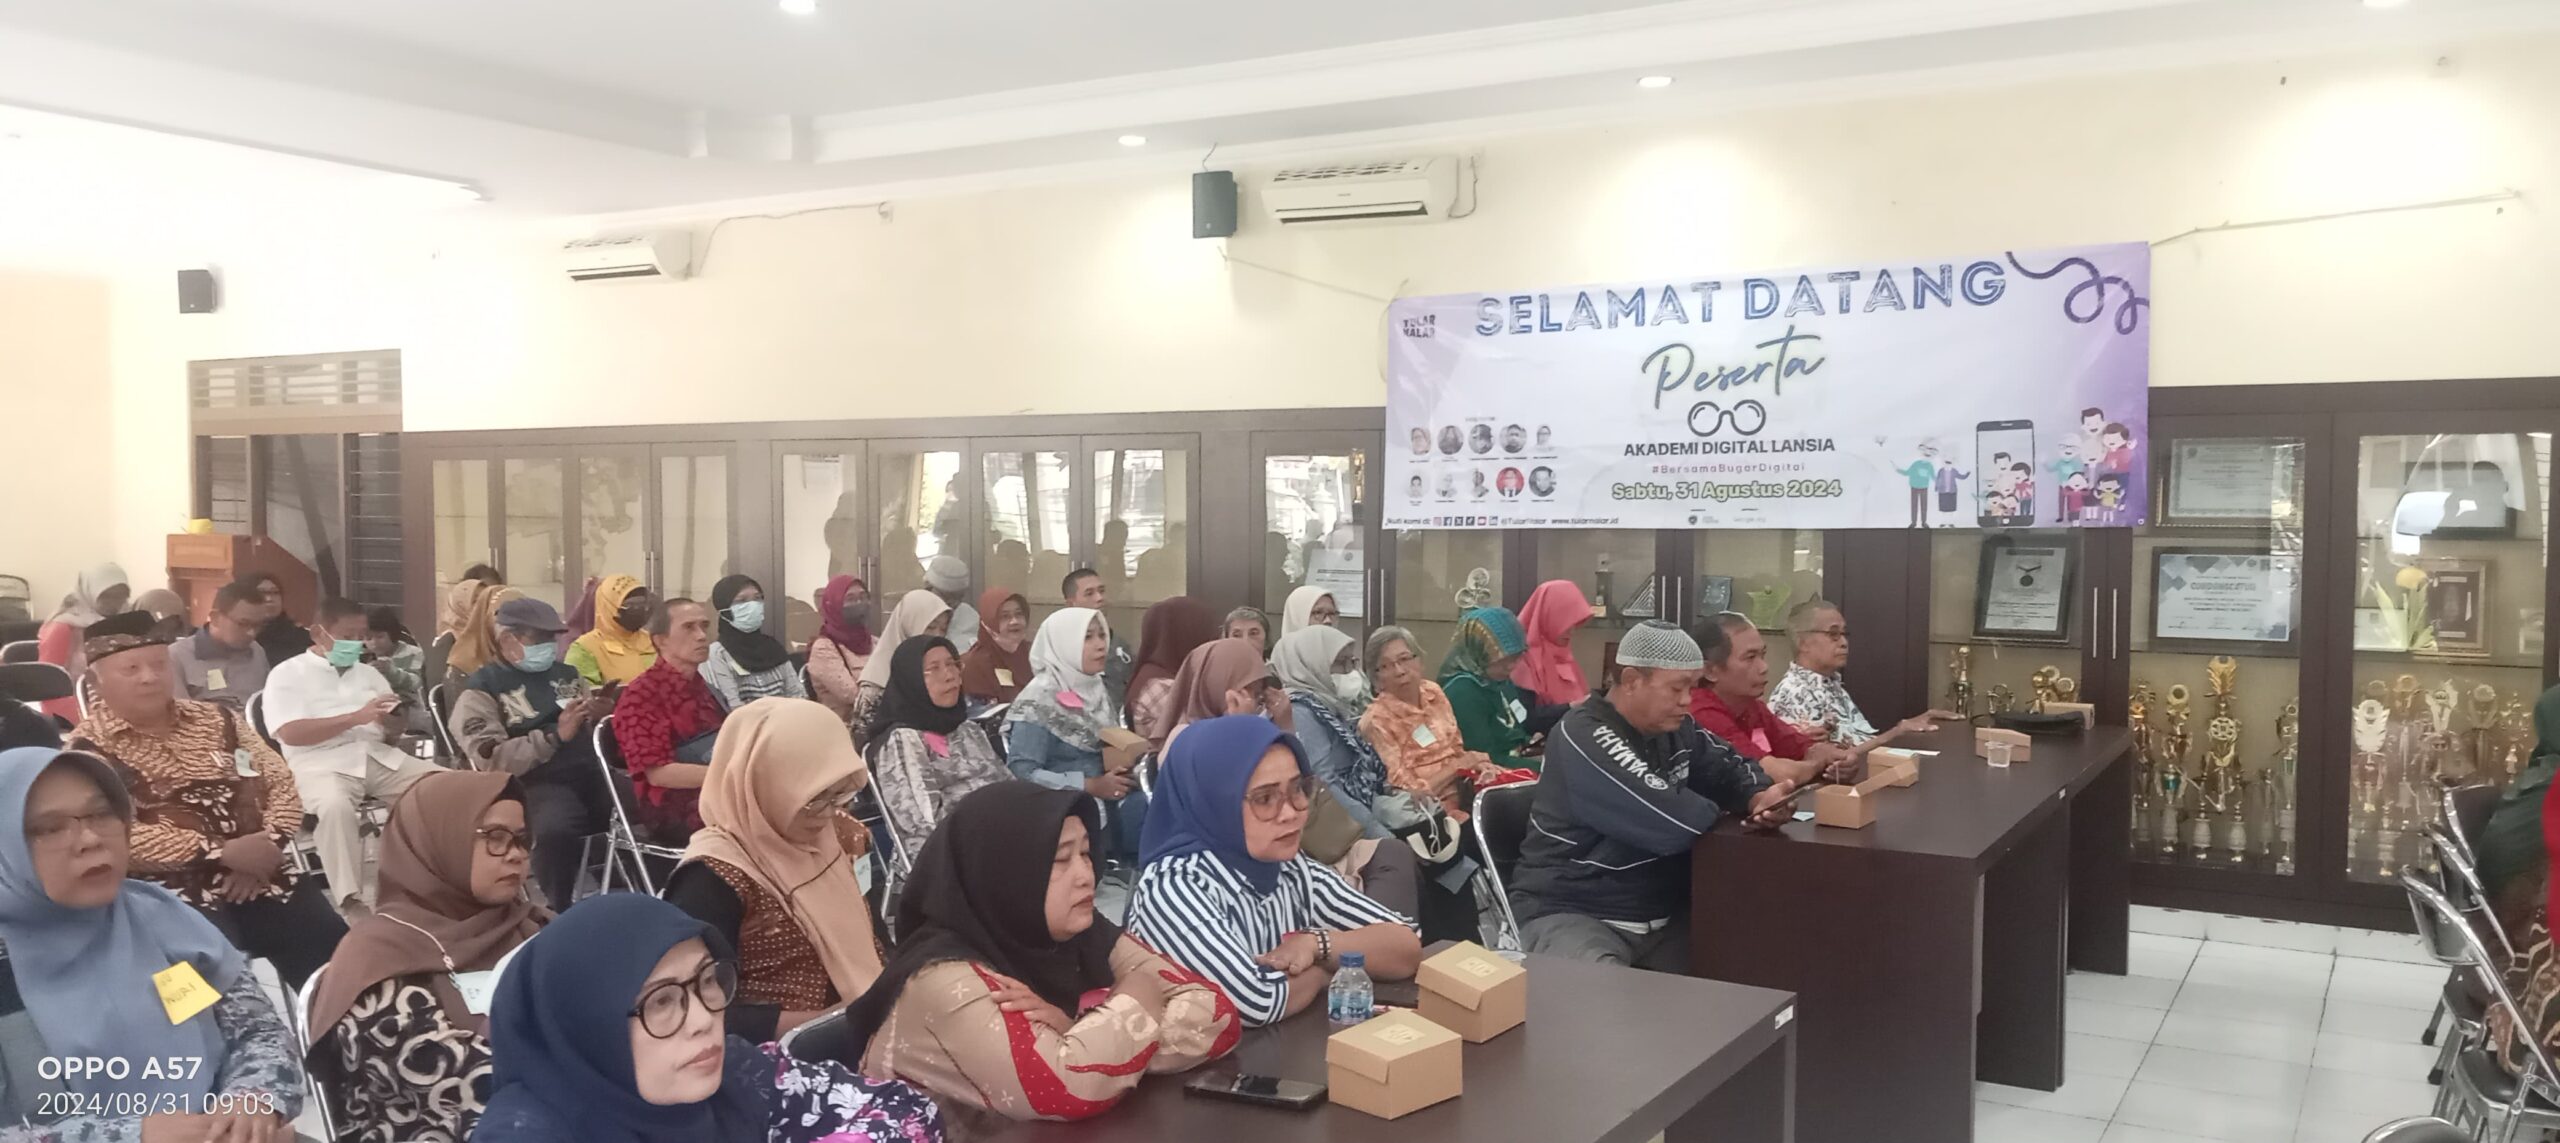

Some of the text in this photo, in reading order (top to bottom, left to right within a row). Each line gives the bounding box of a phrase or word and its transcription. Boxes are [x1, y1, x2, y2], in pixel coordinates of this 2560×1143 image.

[1475, 260, 2007, 336] SELAMAT DATANG
[1641, 324, 1826, 410] Peserta
[1624, 438, 1836, 457] AKADEMI DIGITAL LANSIA
[1612, 479, 1842, 503] Sabtu, 31 Agustus 2024
[1593, 725, 1648, 778] YAMAHA
